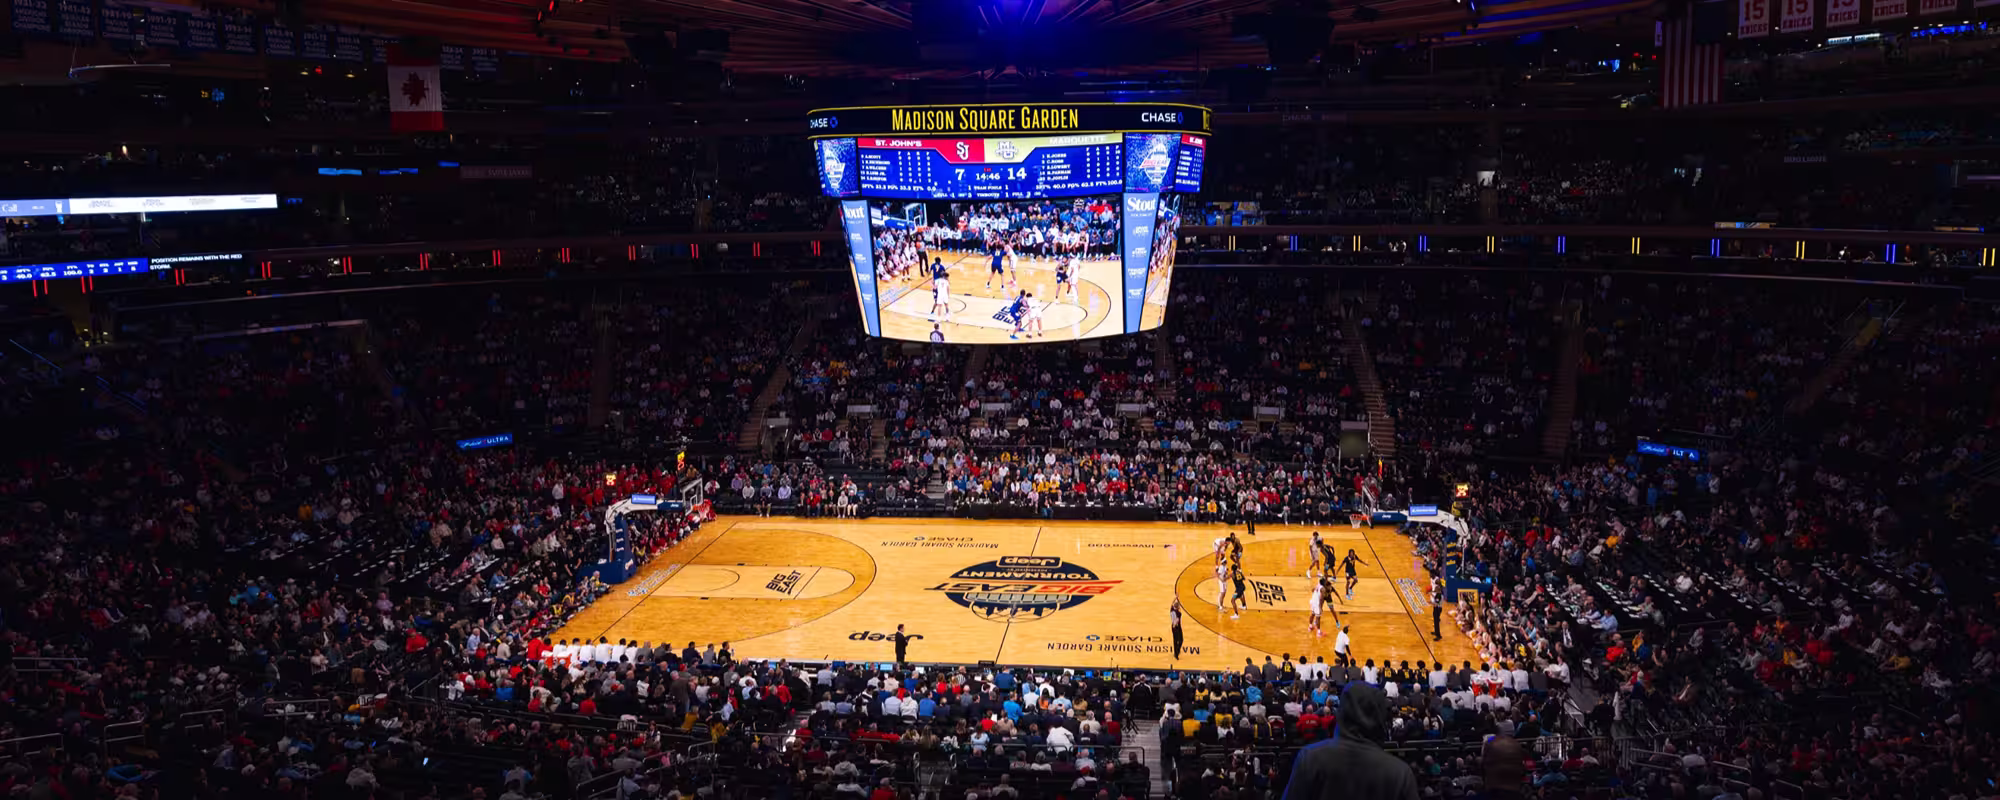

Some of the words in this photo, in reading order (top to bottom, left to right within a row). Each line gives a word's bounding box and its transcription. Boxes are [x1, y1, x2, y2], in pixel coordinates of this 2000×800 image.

[1744, 0, 1764, 21] 15
[1874, 3, 1905, 17] KNICKS
[1828, 10, 1858, 23] KNICKS
[1782, 17, 1812, 29] KNICKS
[1739, 23, 1769, 36] KNICKS
[892, 108, 954, 131] MADISON
[959, 107, 1015, 131] SQUARE
[1021, 106, 1078, 129] GARDEN
[1141, 112, 1176, 122] CHASE
[955, 168, 965, 181] 7
[1007, 167, 1027, 180] 14
[2, 204, 18, 213] Call
[1127, 197, 1156, 212] Stout
[487, 436, 509, 444] ULTRA
[1673, 449, 1695, 458] LTA
[1004, 557, 1057, 566] Jeep
[776, 570, 801, 593] EAST
[958, 571, 1092, 580] TOURNAMENT
[765, 574, 786, 590] BIG
[925, 583, 1038, 593] EAST
[1035, 585, 1114, 594] BIG
[1256, 581, 1273, 606] EAST
[1269, 584, 1287, 602] BIG
[1047, 642, 1092, 652] GARDEN
[1098, 644, 1142, 653] SQUARE
[1146, 644, 1200, 655] MAISON
[1384, 670, 1392, 678] 10
